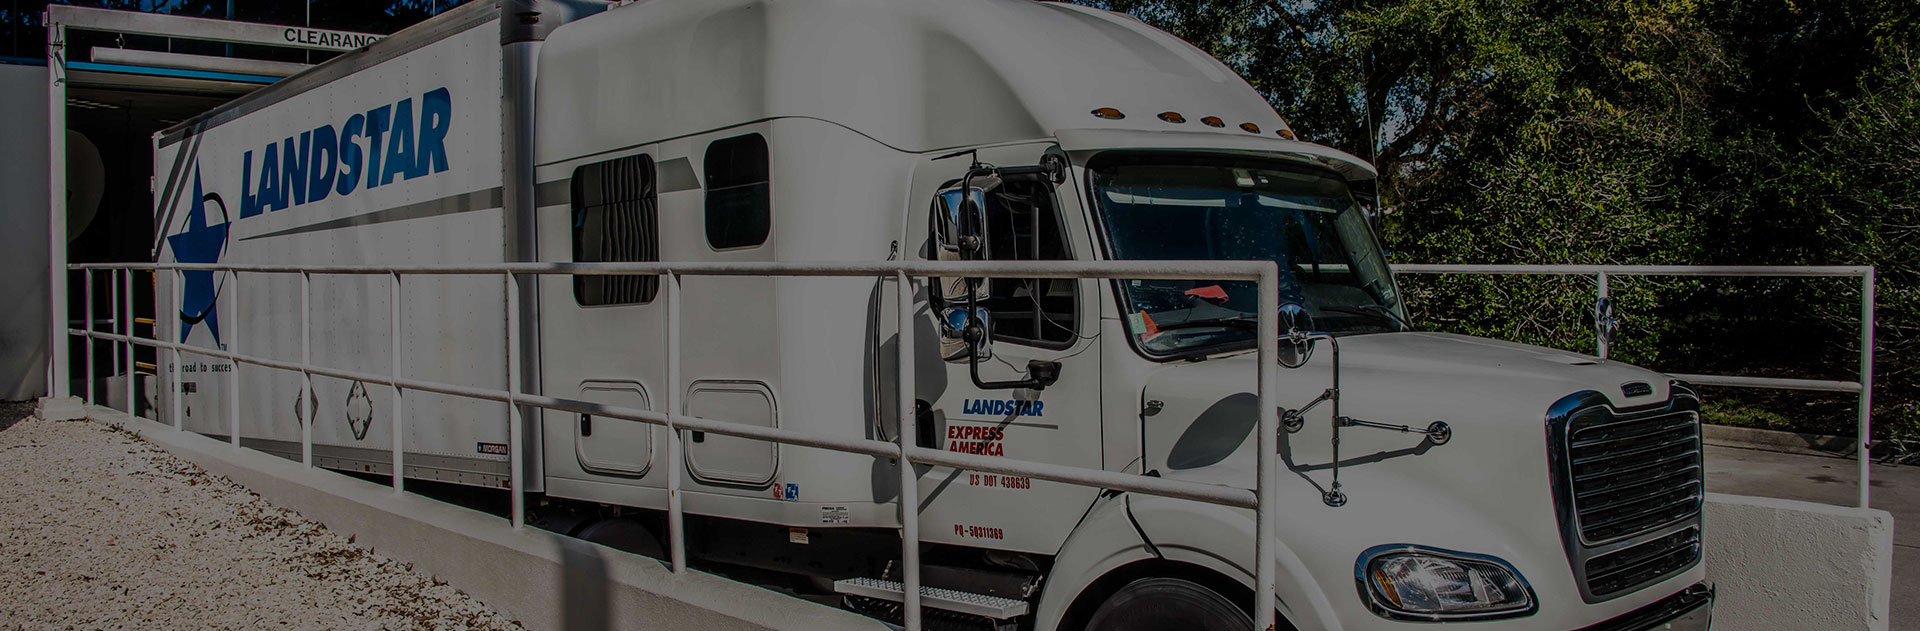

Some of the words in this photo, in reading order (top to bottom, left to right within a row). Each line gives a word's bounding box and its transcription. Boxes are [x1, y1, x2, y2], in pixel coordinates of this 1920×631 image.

[285, 28, 386, 48] CLEARANC
[239, 86, 452, 219] LANDSTAR
[182, 362, 197, 373] road
[200, 362, 208, 373] to
[211, 363, 232, 373] succes
[963, 398, 1044, 417] LANDSTAR
[948, 425, 1004, 441] EXPRESS
[483, 444, 506, 454] MORGAN
[949, 440, 1004, 457] AMERICA
[969, 474, 980, 486] US
[983, 475, 998, 488] DOT
[1000, 476, 1031, 490] 438639
